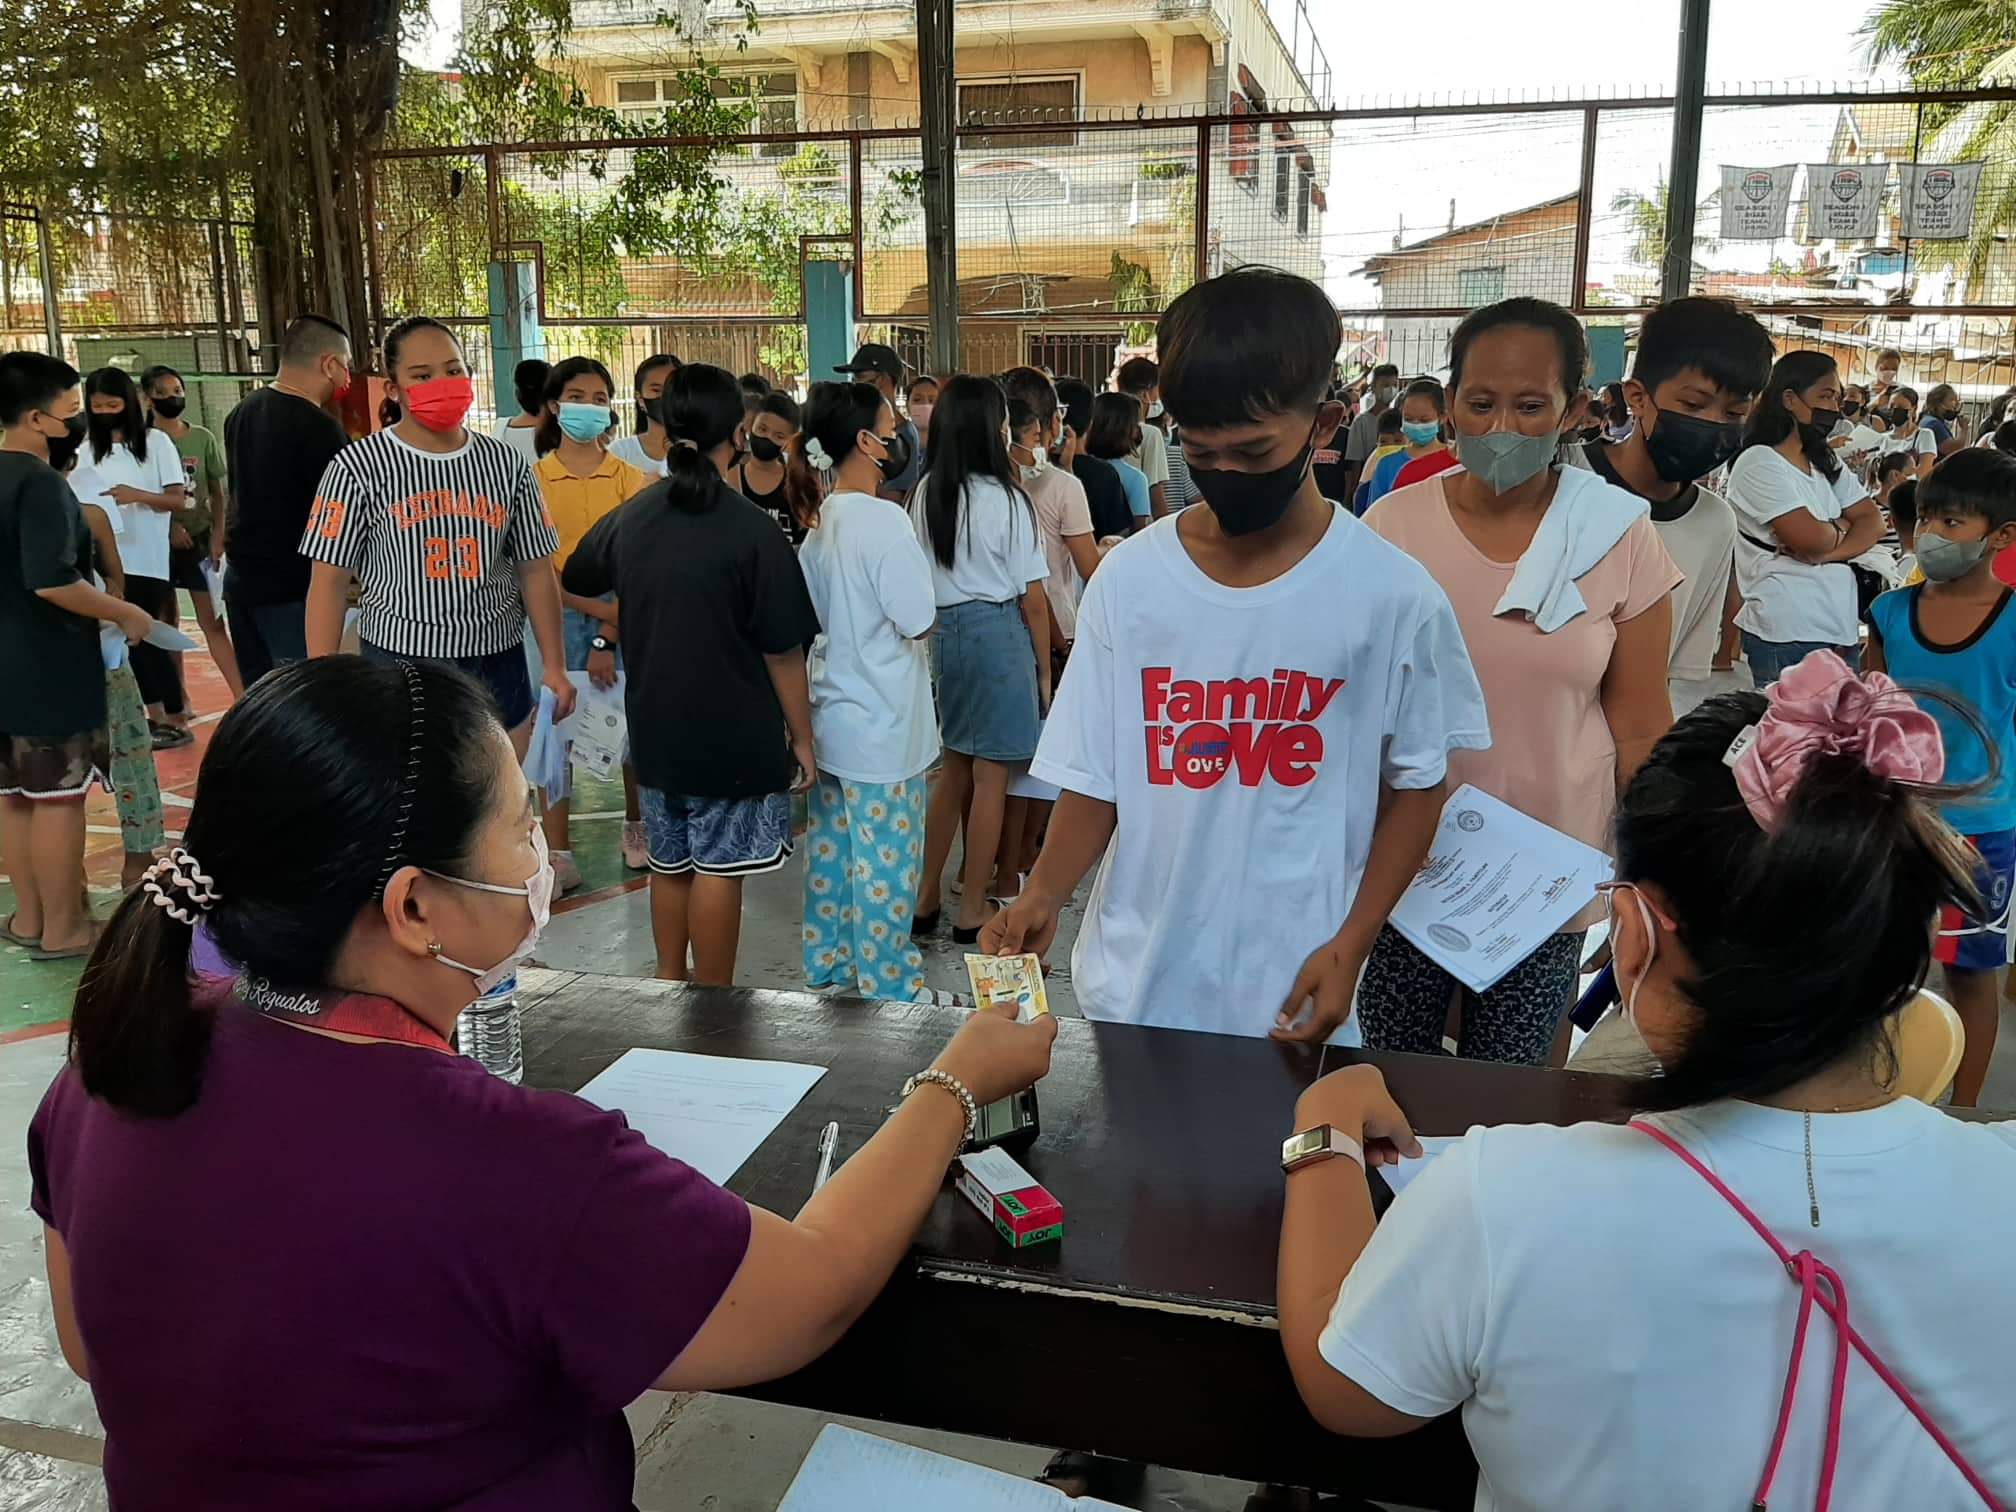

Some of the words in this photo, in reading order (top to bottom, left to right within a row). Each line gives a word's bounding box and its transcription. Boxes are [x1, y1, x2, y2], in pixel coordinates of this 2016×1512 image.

[424, 535, 480, 581] 23
[1140, 666, 1346, 724] Family
[1731, 736, 1747, 755] ACE
[1027, 1229, 1052, 1243] JOY
